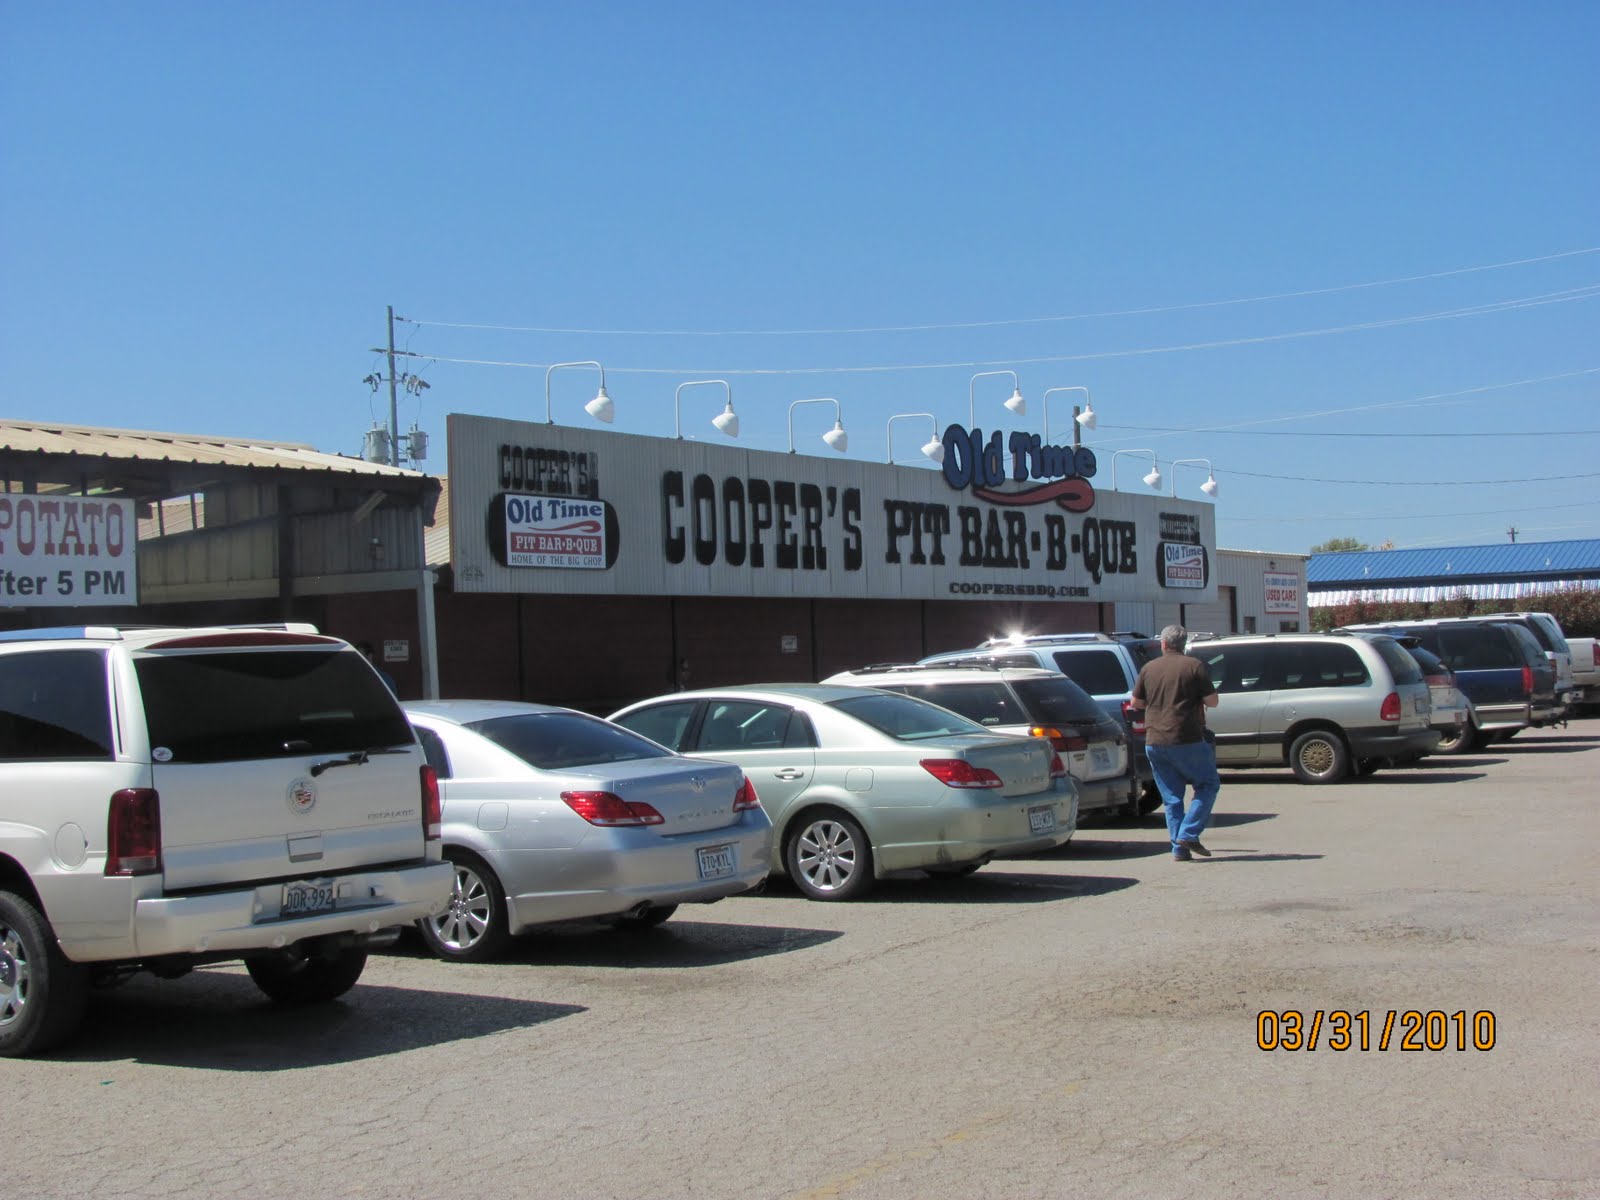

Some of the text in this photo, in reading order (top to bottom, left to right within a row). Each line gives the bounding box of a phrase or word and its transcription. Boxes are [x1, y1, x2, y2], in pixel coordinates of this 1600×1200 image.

[942, 423, 1097, 490] Old Time
[500, 444, 588, 496] COOPER'S
[507, 498, 602, 524] Old Time
[662, 470, 863, 571] COOPER'S
[884, 499, 950, 564] PIT
[515, 535, 536, 550] PIT
[1166, 545, 1202, 561] Old Time
[511, 554, 602, 566] HOME OF THE BIG CHOP
[57, 570, 73, 595] 5
[84, 570, 125, 595] PM
[1265, 589, 1297, 602] USED CARS
